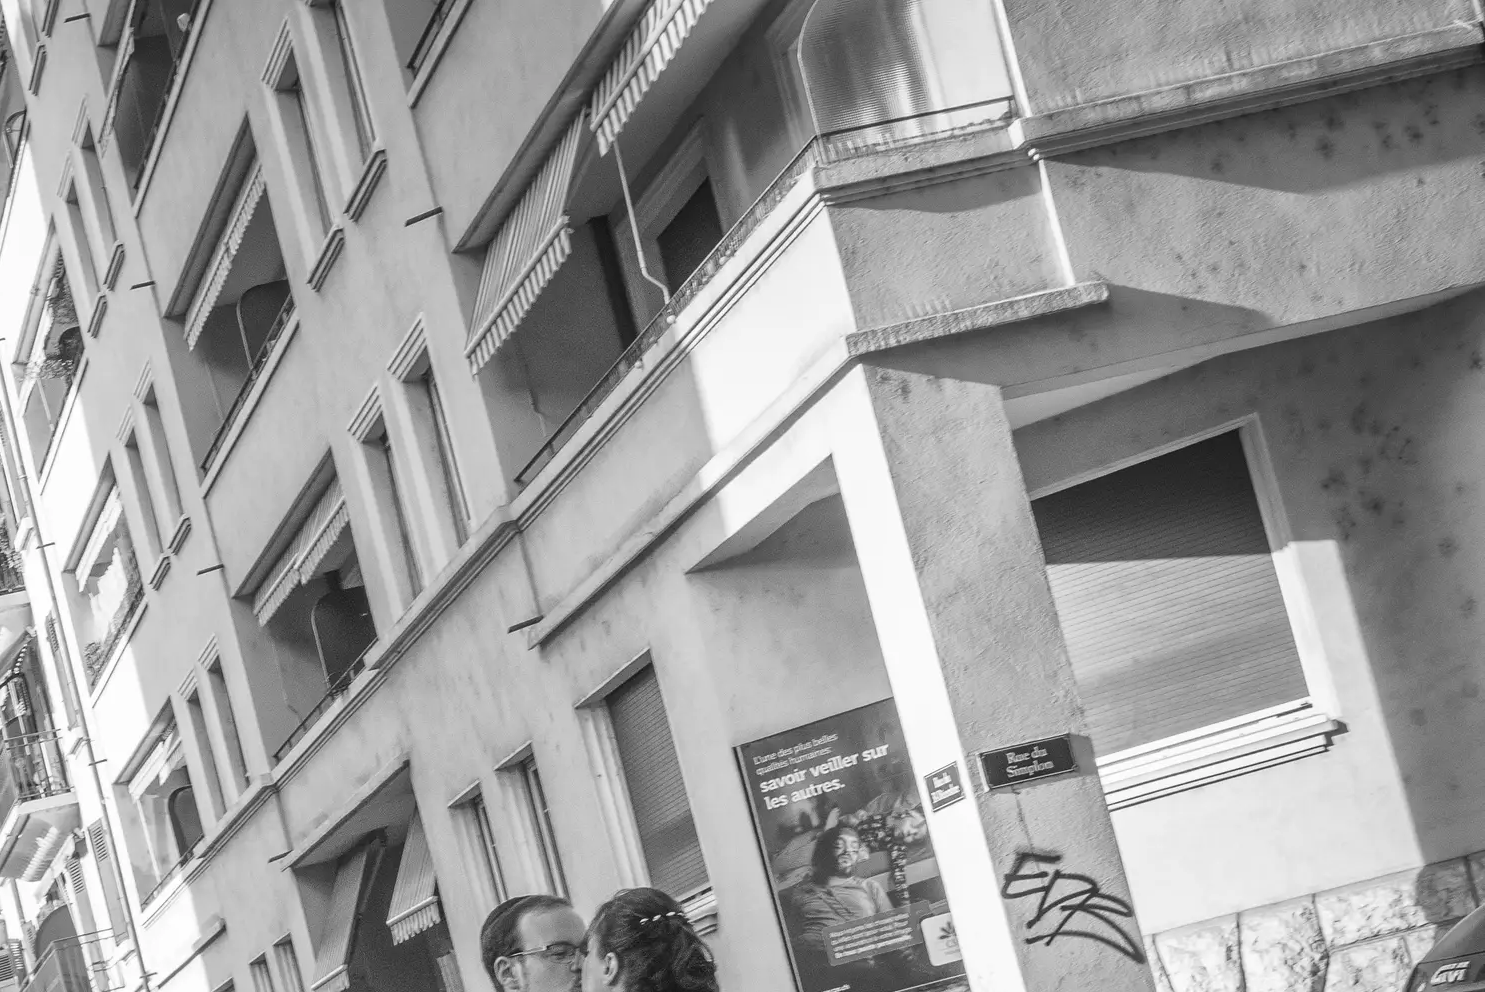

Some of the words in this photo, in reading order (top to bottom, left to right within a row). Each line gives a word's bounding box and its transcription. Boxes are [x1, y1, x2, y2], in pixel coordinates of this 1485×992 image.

[777, 745, 794, 757] des
[794, 740, 813, 755] plus
[813, 733, 839, 747] belles
[1006, 751, 1030, 764] Rue
[1031, 746, 1048, 759] du
[759, 768, 808, 793] savoir
[809, 753, 859, 778] veiller
[862, 744, 889, 762] sur
[1006, 760, 1055, 778] Simplon
[763, 794, 789, 810] les
[791, 778, 846, 803] autres.
